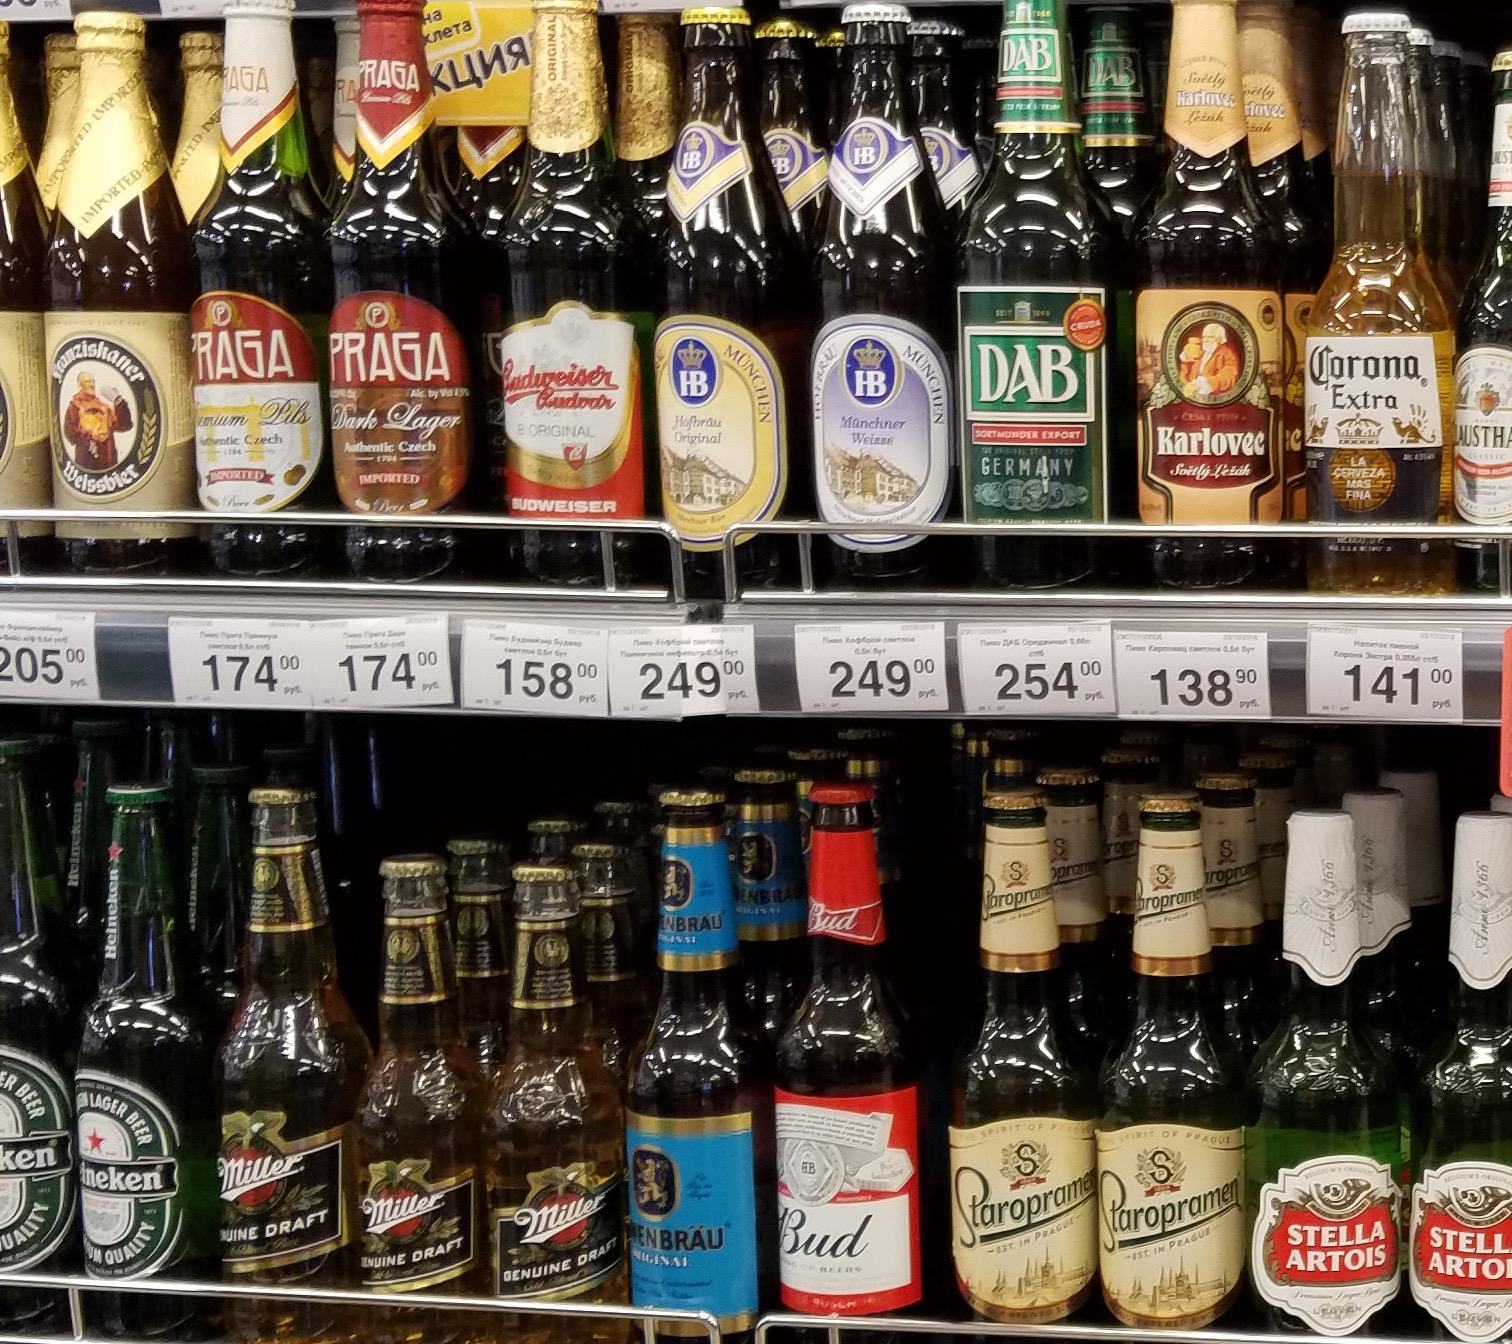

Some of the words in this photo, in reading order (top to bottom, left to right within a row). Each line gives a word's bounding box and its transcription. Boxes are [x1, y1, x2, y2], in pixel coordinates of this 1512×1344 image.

[330, 331, 450, 382] PRAGA
[1310, 345, 1420, 390] Corona
[724, 345, 770, 424] MÜNCHEN
[903, 346, 944, 425] MÜNCHEN
[978, 344, 1078, 403] DAB
[1331, 384, 1399, 410] Extra
[332, 404, 377, 430] Dark
[386, 402, 461, 439] Lager
[672, 415, 722, 430] Hofbräu
[840, 416, 906, 430] Münchner
[344, 442, 396, 454] Authentic
[399, 442, 436, 453] Czech
[674, 430, 721, 445] Original
[1157, 426, 1266, 456] Karlovec
[359, 473, 420, 486] IMPORTED
[981, 456, 1073, 476] GERMANY
[511, 498, 616, 514] BUDWEISER
[202, 654, 276, 694] 174
[279, 654, 300, 672] 00
[996, 662, 1078, 701] 254
[1080, 660, 1101, 678] 00
[1150, 668, 1232, 707] 138
[1236, 668, 1258, 686] 90
[104, 866, 120, 960] Heineken
[808, 907, 859, 934] Bud
[1286, 1220, 1384, 1247] STELLA
[411, 1236, 464, 1262] DRAFT
[1286, 1246, 1386, 1272] ARTOIS
